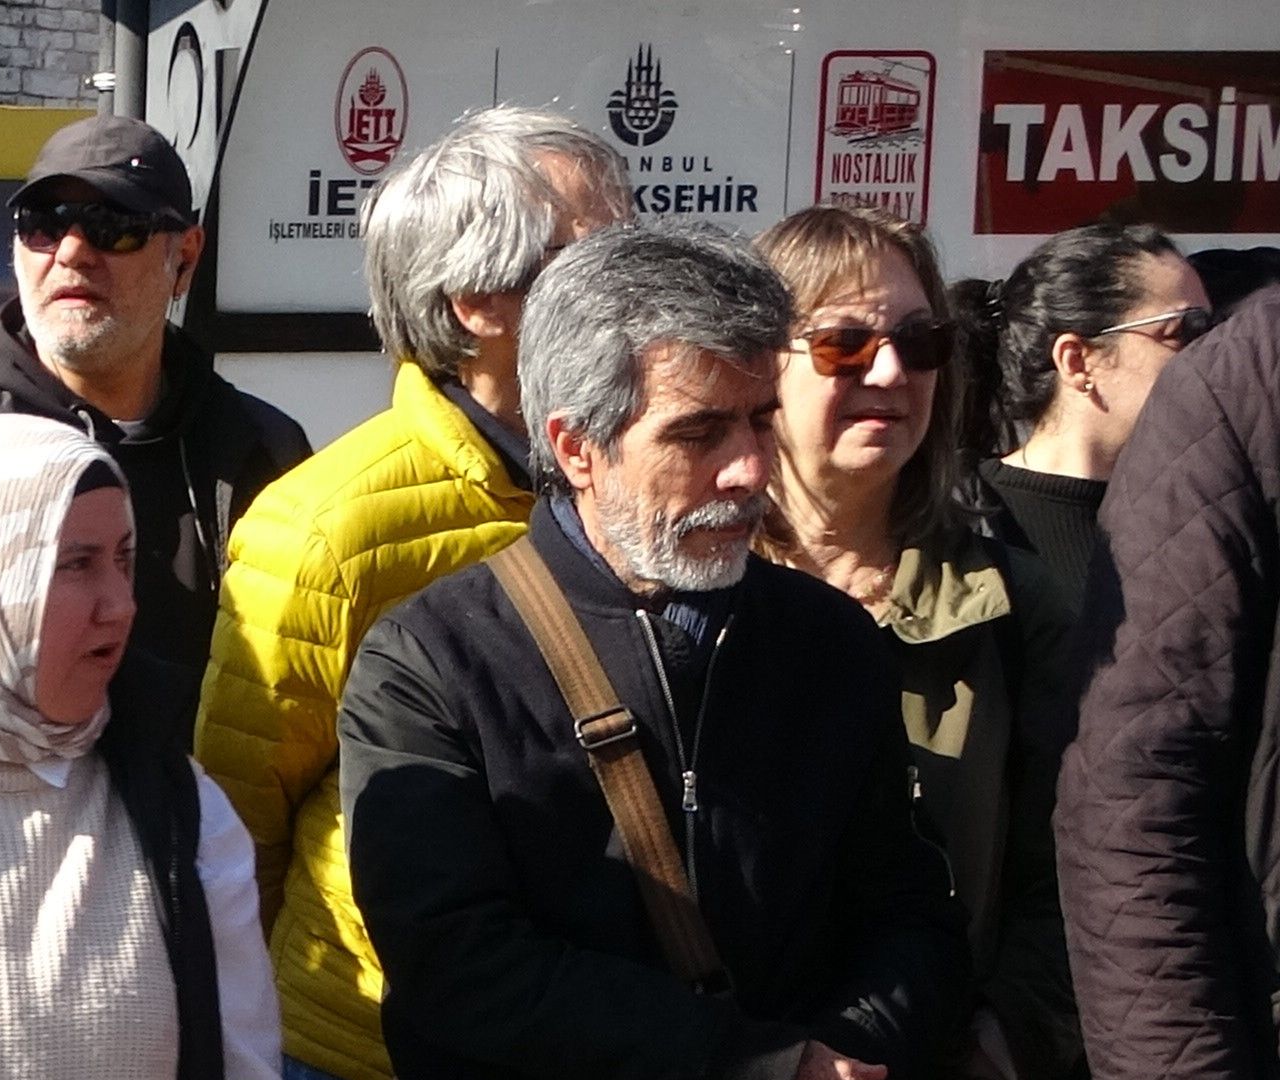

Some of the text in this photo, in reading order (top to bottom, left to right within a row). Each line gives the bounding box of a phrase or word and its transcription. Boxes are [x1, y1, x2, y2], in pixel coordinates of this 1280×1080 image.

[993, 86, 1280, 183] TAKSİM
[831, 148, 917, 184] NOSTALJİK
[308, 169, 378, 216] İE
[269, 219, 345, 243] İŞLETMELERİ
